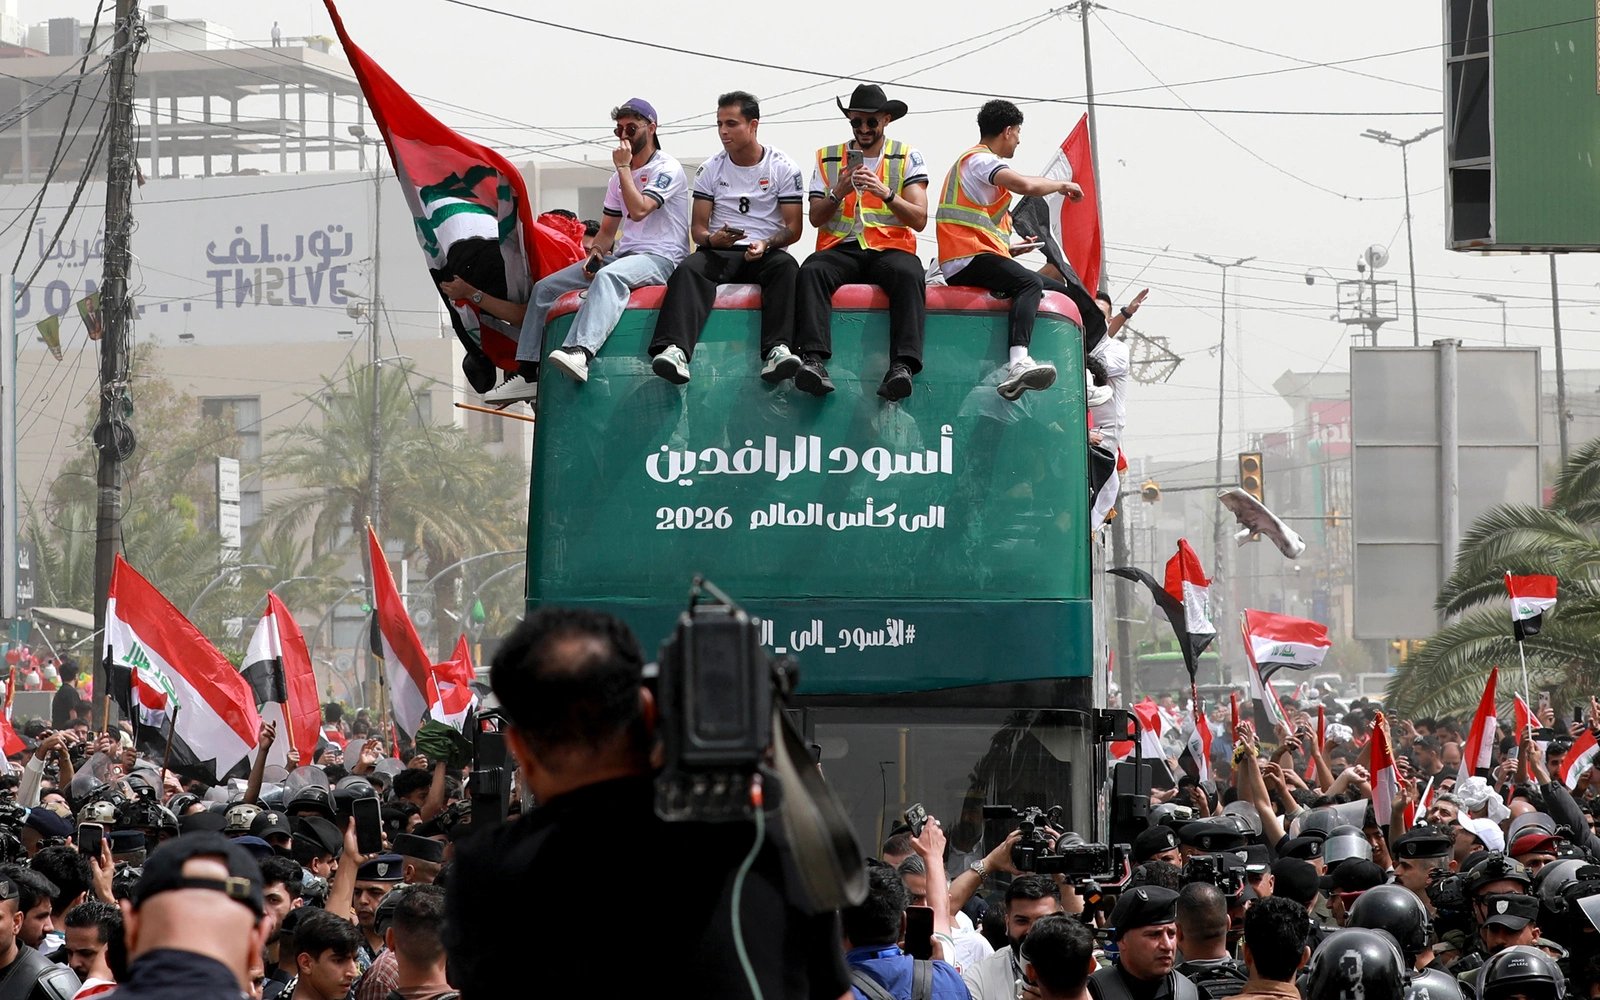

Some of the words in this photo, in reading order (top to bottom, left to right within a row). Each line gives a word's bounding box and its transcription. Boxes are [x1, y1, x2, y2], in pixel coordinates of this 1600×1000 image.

[738, 196, 750, 214] 8
[645, 434, 822, 487] الرافدين
[828, 424, 953, 482] أسود
[655, 506, 733, 530] 2026
[749, 502, 823, 530] العالم
[826, 496, 897, 531] كأس
[759, 618, 916, 654] #الأسود_الى_ال
